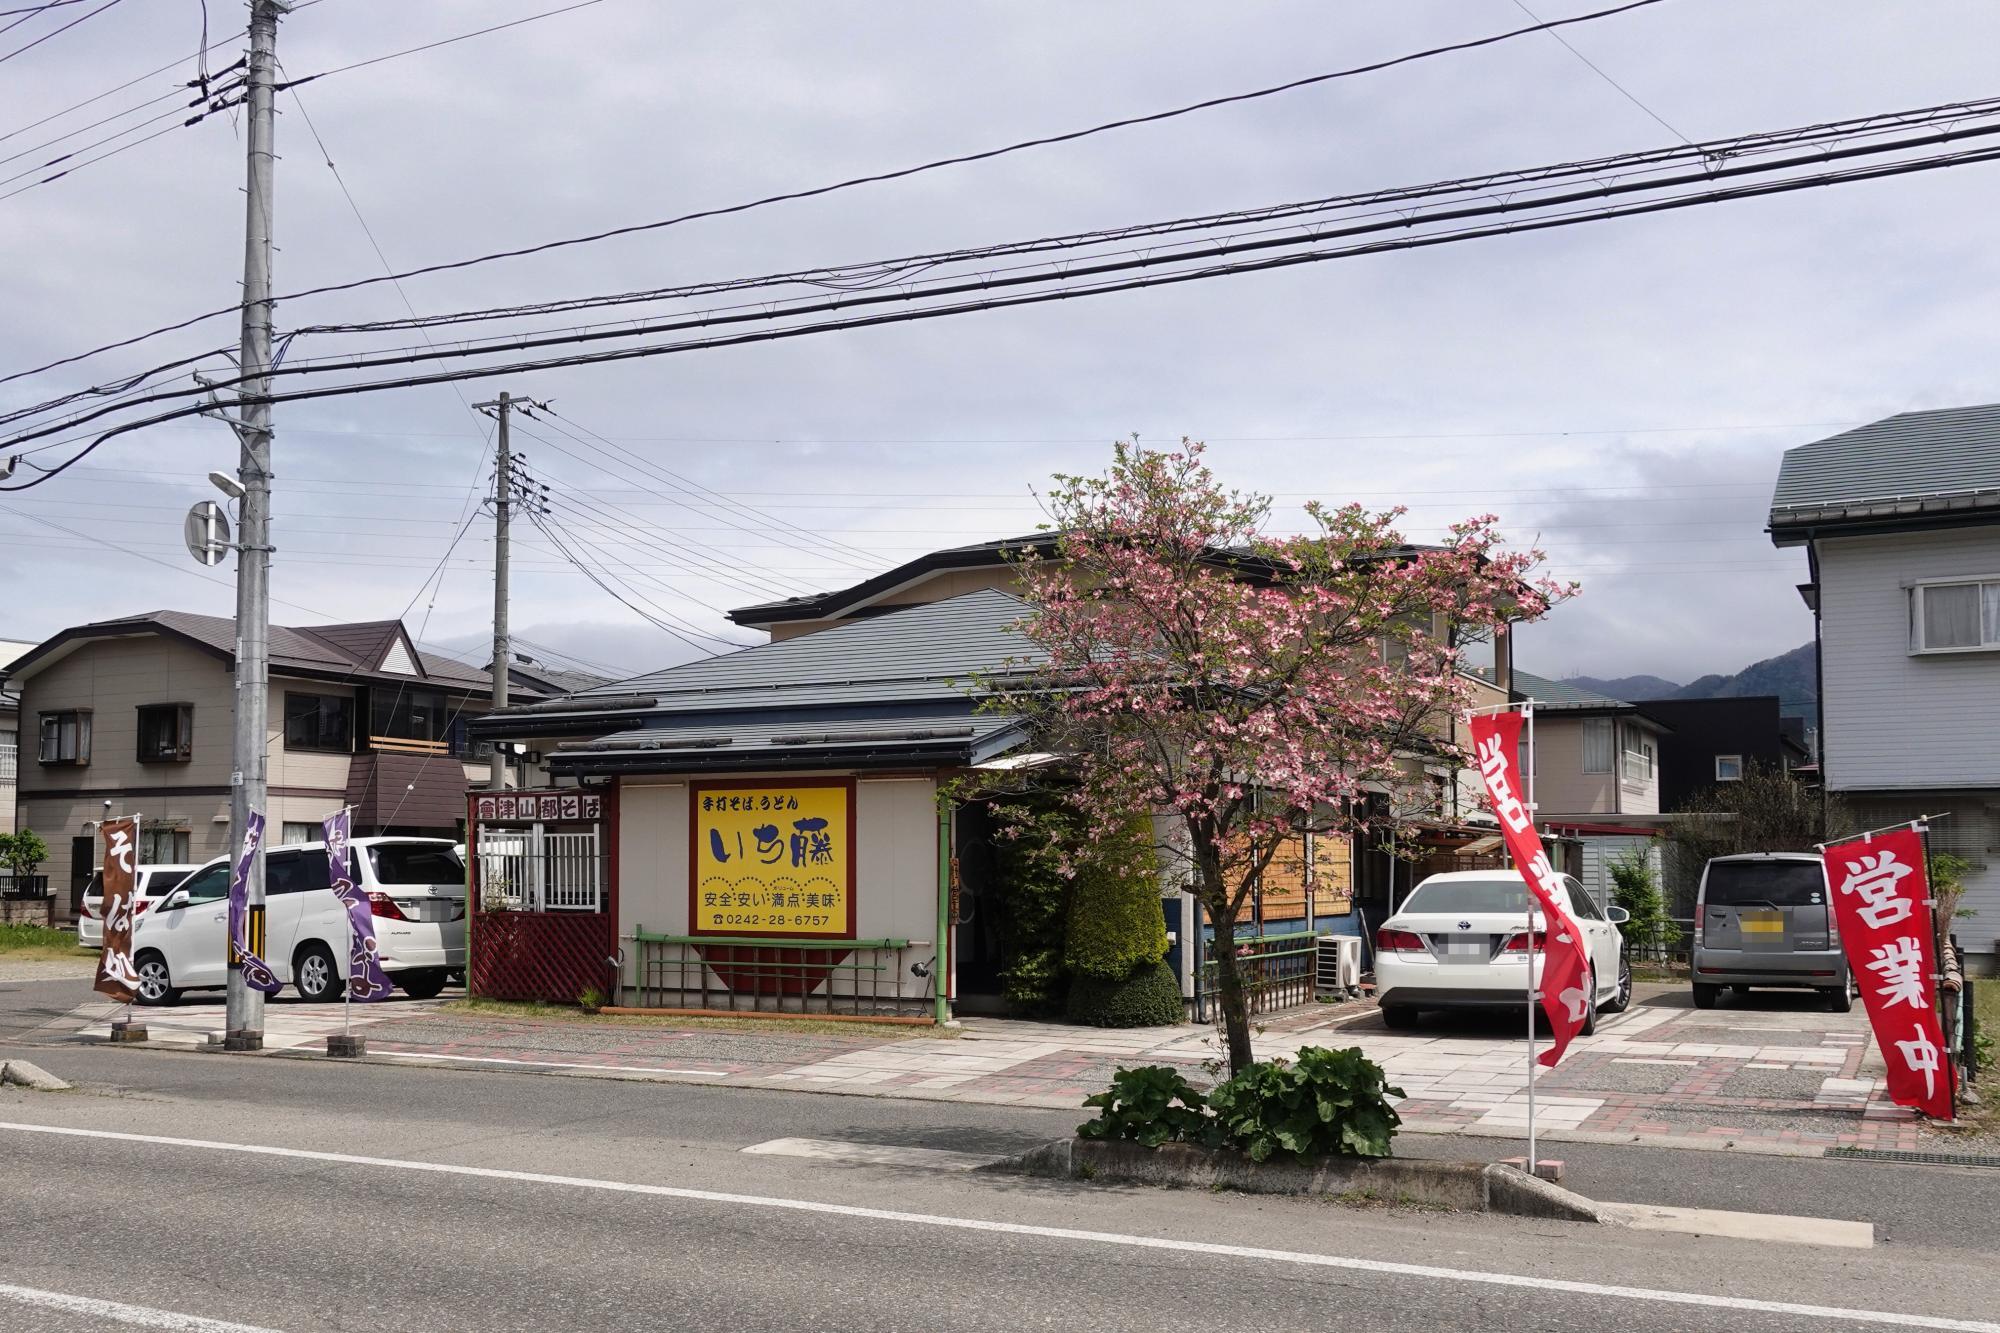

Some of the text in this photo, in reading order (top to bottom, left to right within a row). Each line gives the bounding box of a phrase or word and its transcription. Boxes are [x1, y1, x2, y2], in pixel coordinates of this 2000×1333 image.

[480, 799, 599, 819] 會津山都そば
[709, 817, 834, 868] いち藤
[726, 914, 829, 926] 0242-28-6757
[1840, 850, 1940, 1100] 営業中
